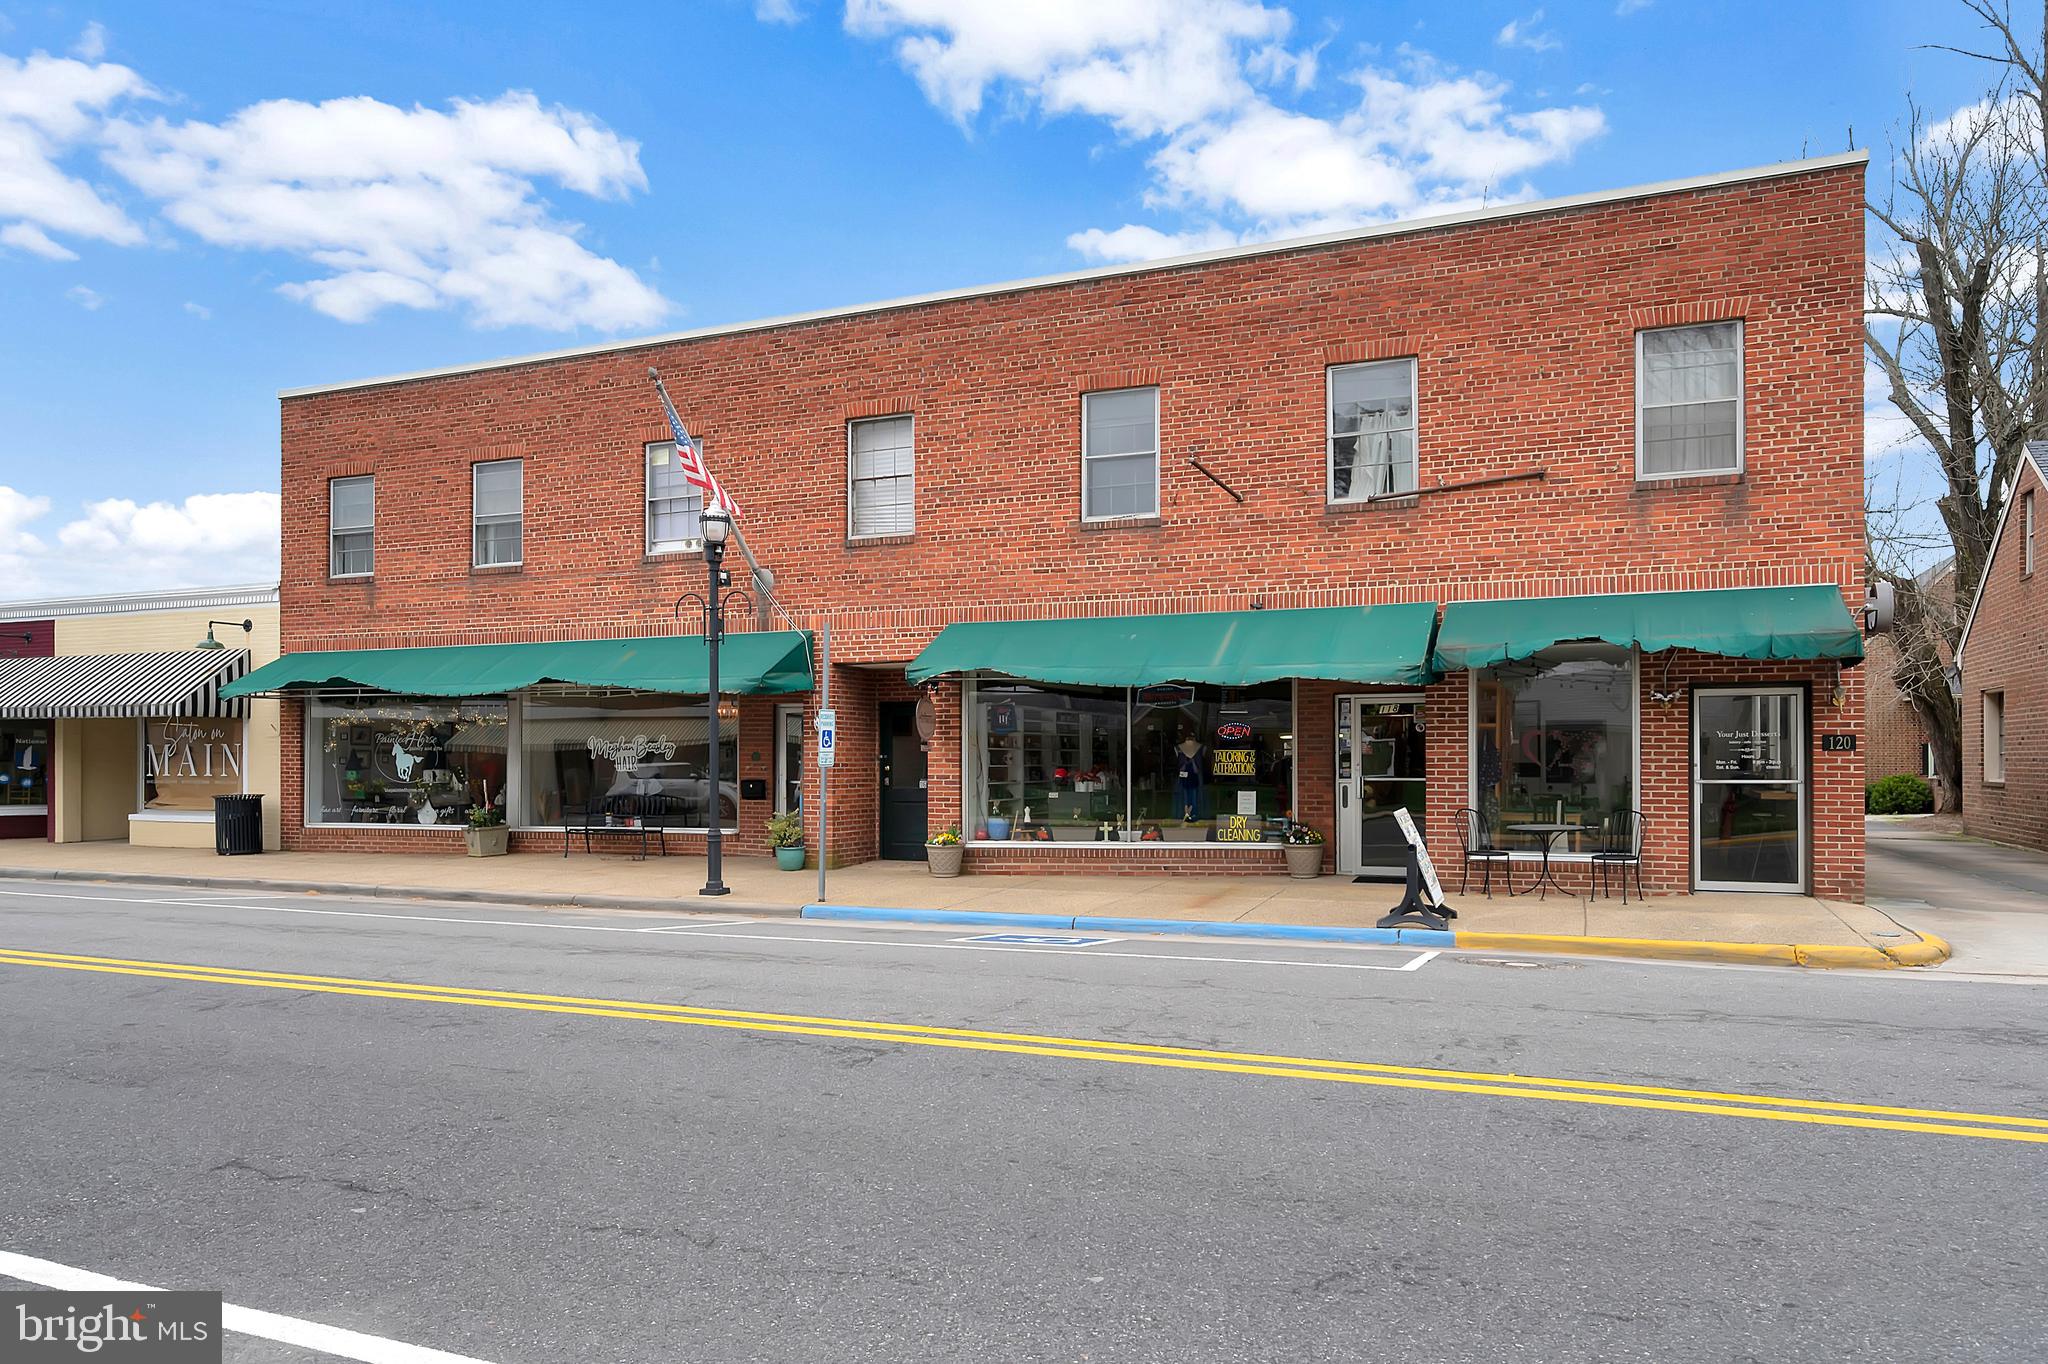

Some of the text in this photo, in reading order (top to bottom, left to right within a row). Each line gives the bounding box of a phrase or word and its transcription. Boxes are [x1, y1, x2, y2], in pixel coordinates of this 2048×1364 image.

[211, 727, 225, 740] on
[1217, 726, 1251, 737] OPEN
[1716, 730, 1734, 738] Your
[1734, 730, 1750, 739] Just
[375, 729, 438, 751] Painted Horse
[1829, 735, 1851, 750] 120
[587, 734, 676, 760] Meghan Beasley
[146, 743, 241, 777] MAIN
[615, 756, 638, 771] HAIR
[1214, 751, 1256, 763] TAILORING &
[1213, 762, 1256, 775] ALTERATIONS
[440, 806, 455, 817] gifts
[1230, 816, 1248, 829] DRY
[1217, 828, 1261, 842] CLEANING
